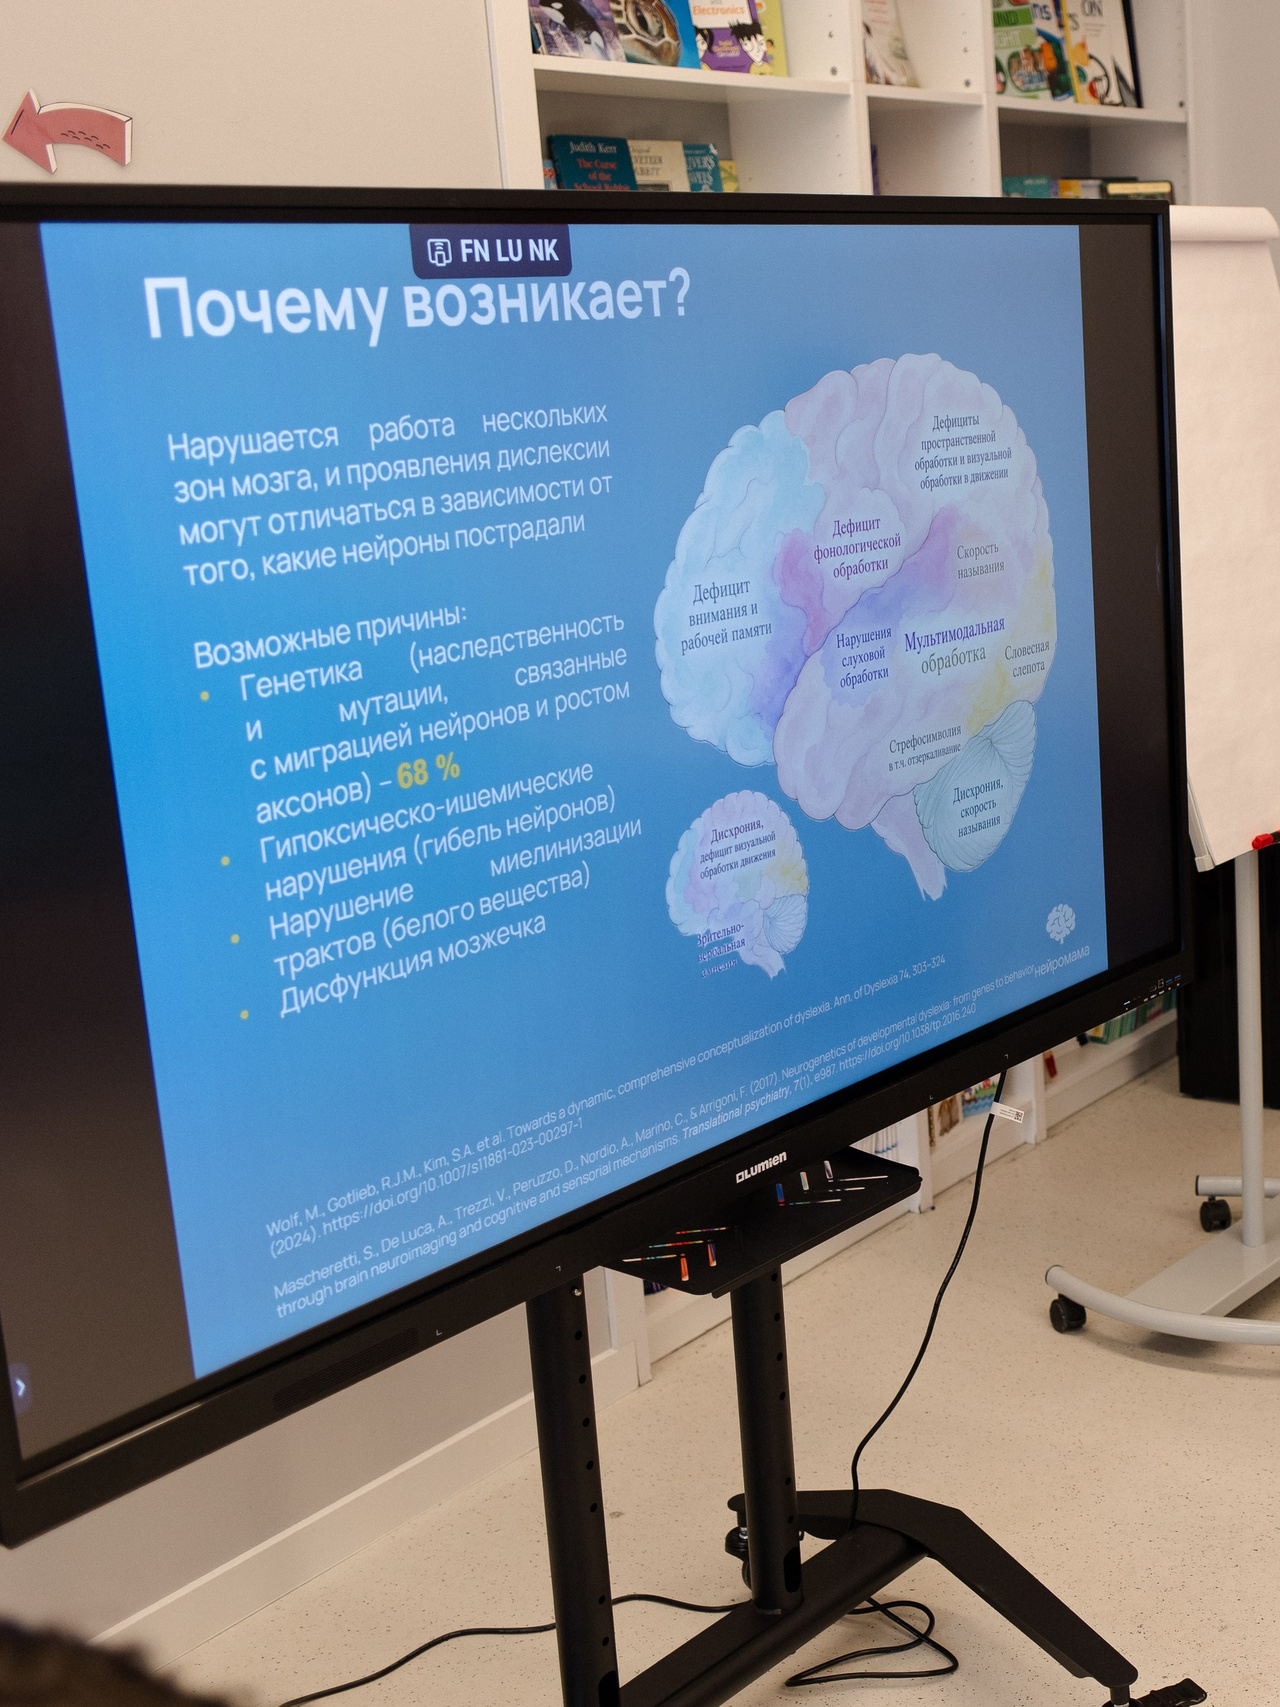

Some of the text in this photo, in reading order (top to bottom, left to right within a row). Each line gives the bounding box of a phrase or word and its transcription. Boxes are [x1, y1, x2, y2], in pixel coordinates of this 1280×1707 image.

[692, 5, 745, 15] Electronics
[570, 141, 617, 154] Judith Kerr
[460, 238, 560, 263] FN LU NK
[144, 267, 691, 347] Почему возникает?
[168, 403, 608, 466] Нарушается работа нескольких
[933, 414, 980, 431] Дефициты
[921, 430, 996, 450] пространственной
[174, 439, 610, 503] зон мозга, и проявления дислексии
[914, 448, 1012, 471] обработки и визуальной
[920, 468, 1008, 491] обработки в движении
[179, 474, 613, 547] могут отличаться в зависимости от
[832, 516, 881, 537] Дефицит
[184, 512, 585, 586] того, какие нейроны пострадали
[814, 534, 901, 563] фонологической
[957, 542, 999, 560] Скорость
[833, 558, 889, 579] обработки
[958, 560, 1005, 580] называния
[693, 579, 751, 605] Дефицит
[689, 604, 758, 627] внимания и
[194, 605, 468, 669] Возможные причины:
[681, 623, 772, 656] рабочей памяти
[836, 626, 892, 649] Нарушения
[904, 616, 1005, 652] Мультимодальная
[240, 610, 625, 701] Генетика (наследственность
[841, 646, 886, 667] слуховой
[921, 647, 986, 675] обработка
[1004, 639, 1050, 661] Словесная
[840, 666, 889, 689] обработки
[1013, 660, 1045, 679] слепота
[246, 646, 628, 741] и мутации, связанные
[251, 681, 630, 780] с миграцией нейронов и ростом
[889, 724, 962, 754] Стрефосимволия
[889, 742, 961, 770] в т.ч. отзеркаливание
[256, 753, 460, 825] аксонов) 68 %
[953, 778, 1004, 804] Дисхрония,
[260, 761, 594, 863] Гипоксическо-ишемические
[961, 799, 997, 819] скорость
[711, 818, 764, 845] Дисхрония,
[958, 815, 1001, 838] называния
[265, 785, 617, 902] нарушения (гибель нейронов)
[700, 831, 776, 864] дефицит визуальной
[700, 848, 776, 880] обработки движения
[269, 816, 642, 941] Нарушение миелинизации
[274, 861, 590, 981] трактов (белого вещества)
[696, 921, 744, 948] Зрительно-
[698, 936, 746, 962] вербальная
[1034, 945, 1090, 977] нейромама
[280, 913, 547, 1018] Дисфункция мозжечка
[266, 1212, 306, 1238] Wolf,
[327, 1184, 380, 1213] Gotlieb,
[381, 1166, 422, 1189] R.J.M.,
[423, 1154, 450, 1174] Kim,
[452, 1144, 476, 1162] S.A.
[477, 1138, 492, 1152] et
[492, 1130, 506, 1144] al.
[506, 1112, 557, 1139] Towards
[568, 1090, 617, 1116] dynamic,
[617, 1054, 696, 1094] comprehensive
[697, 1021, 783, 1063] conceptualization
[783, 1014, 794, 1027] of
[794, 1001, 832, 1024] dyslexia.
[834, 991, 853, 1009] Ann.
[854, 988, 864, 999] of
[864, 974, 899, 998] Dyslexia
[899, 969, 911, 985] 74,
[274, 964, 1034, 1299] Mascheretti, De Luca, Trezzi, Peruzzo, Nordio, Marino, Arrigoni, (2017). Neurogenetics of developmental dyslexia: from genes to behavior
[277, 1003, 977, 1319] through brain neuroimaging and cognitive and sensorial mechanisms. Translational psychiatry, 7(1), e987. https://doi.org/10.1038/tp.2016.240
[744, 1152, 787, 1179] Lumien
[270, 1118, 583, 1259] (2024). https://doi.org/10.1007/s11881-023-00297-1
